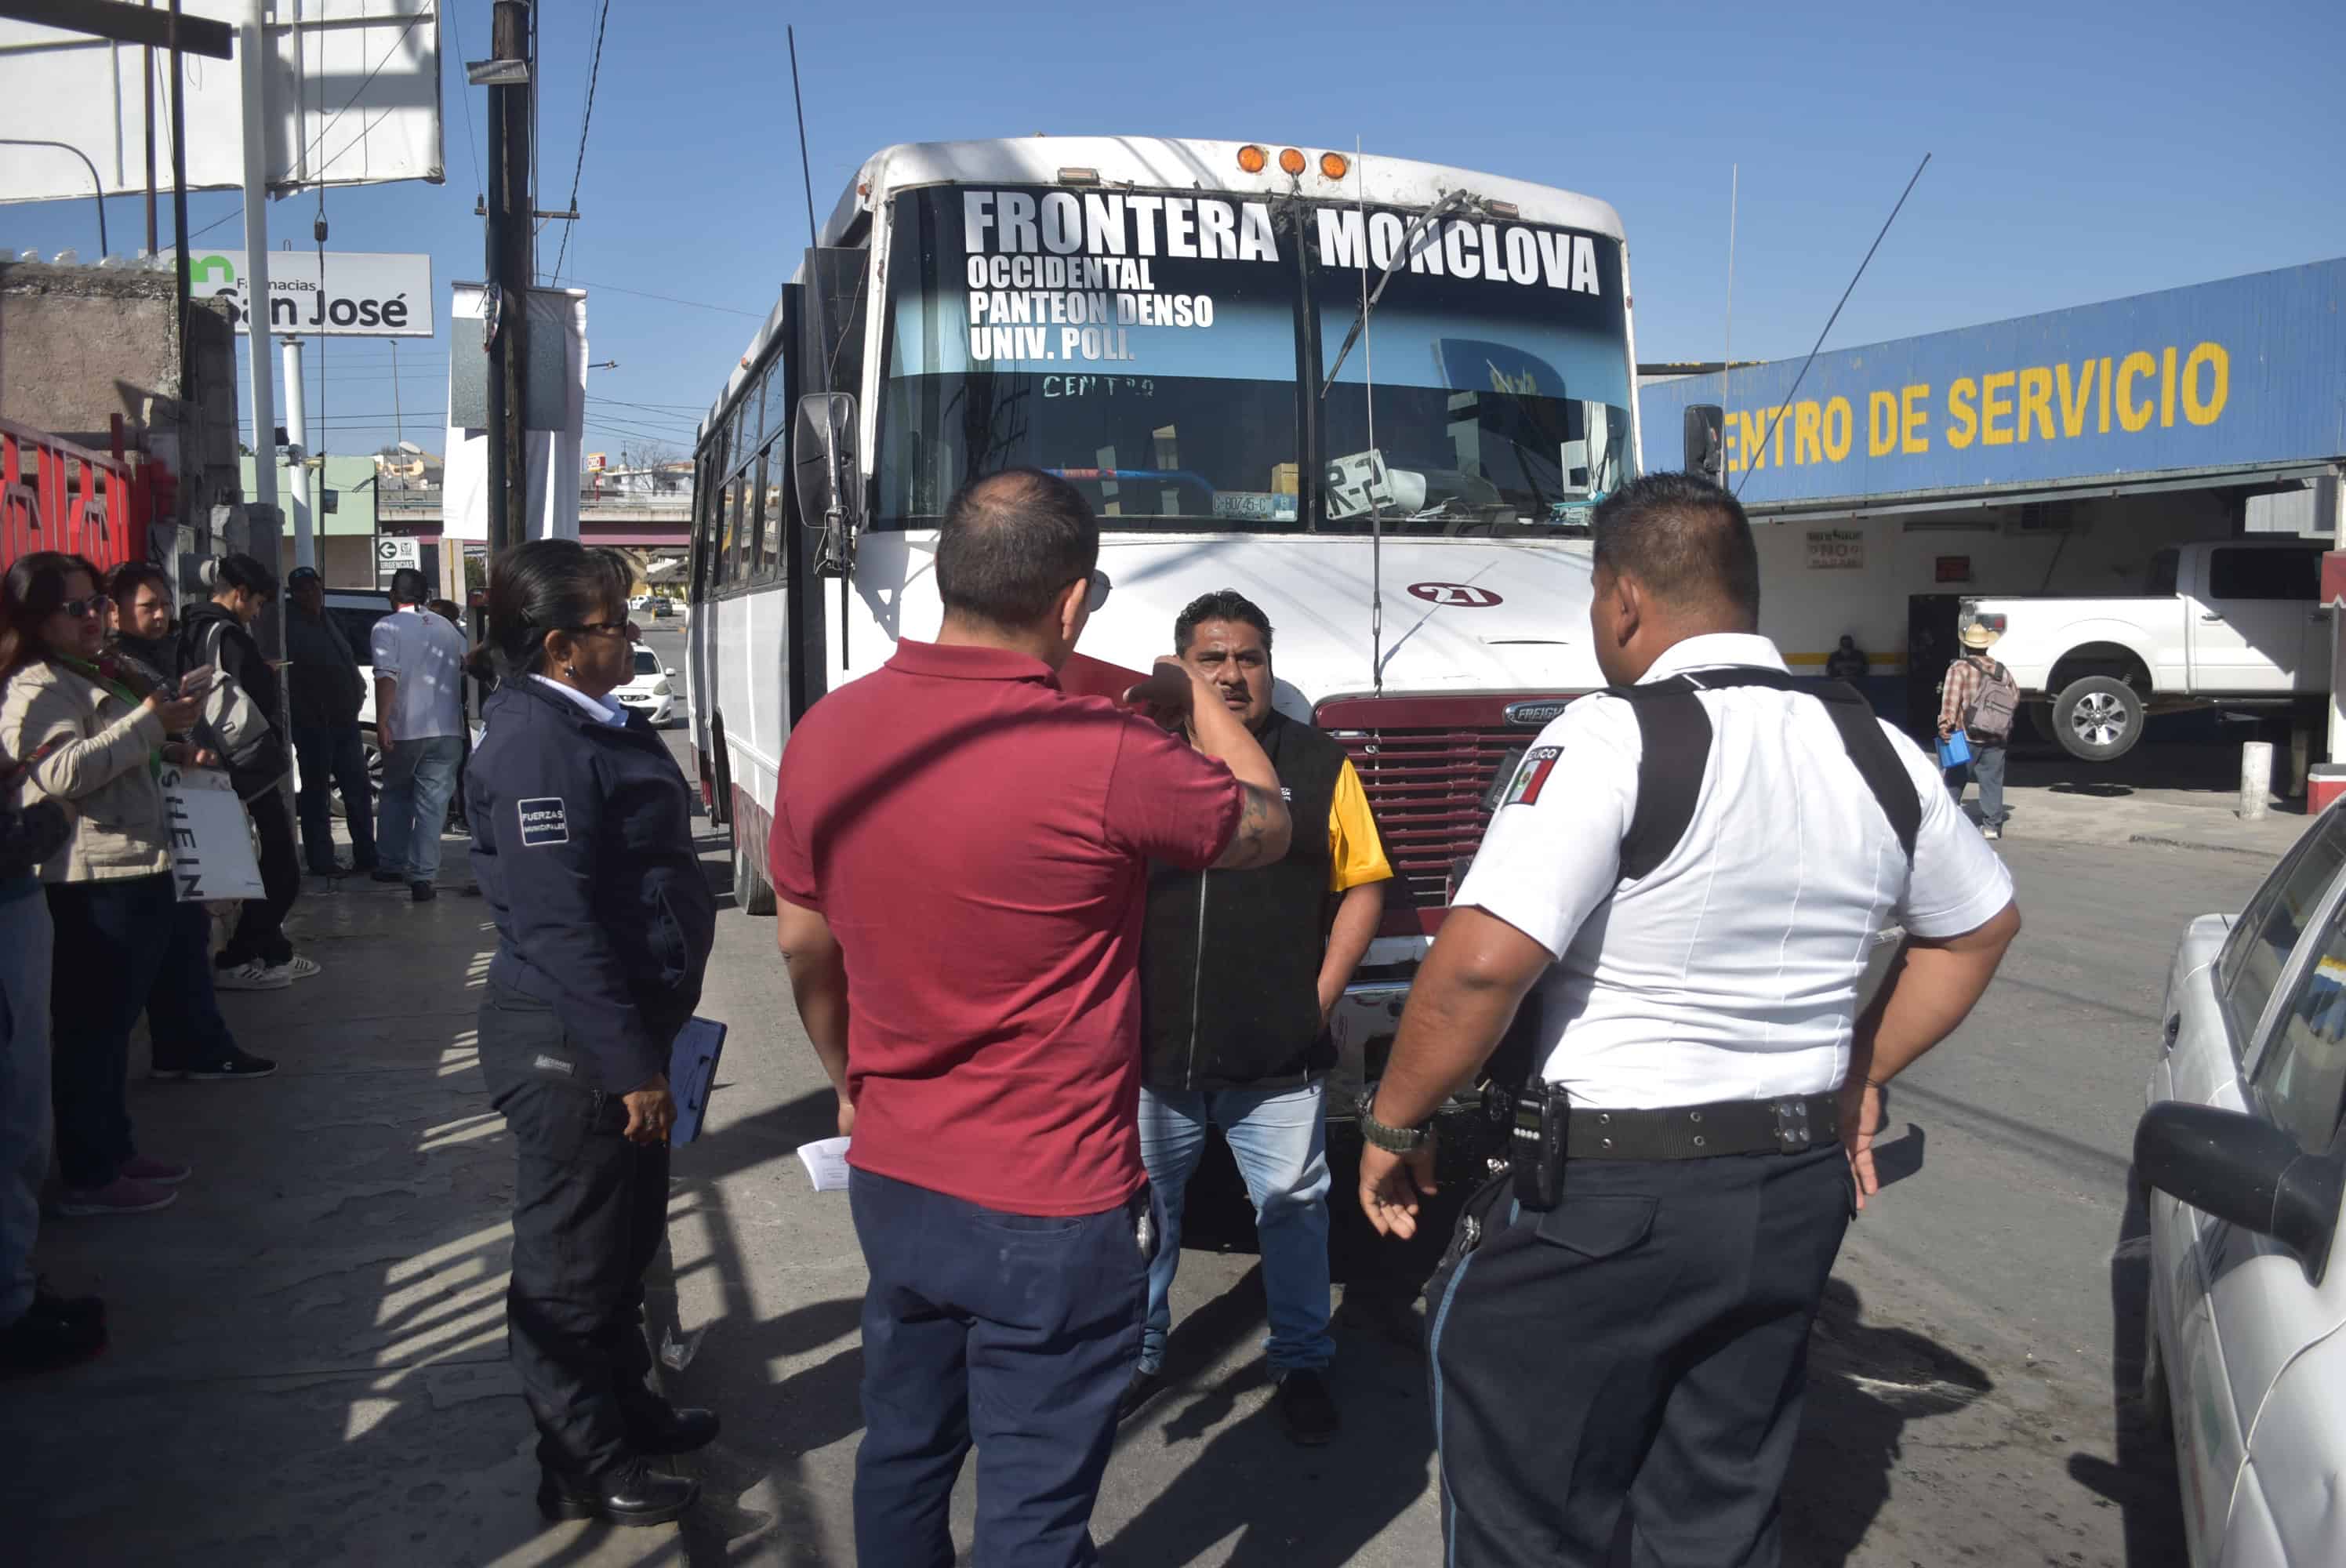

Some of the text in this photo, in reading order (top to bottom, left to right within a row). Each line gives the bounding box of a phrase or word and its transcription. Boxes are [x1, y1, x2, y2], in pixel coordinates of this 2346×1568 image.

[963, 191, 1280, 262] FRONTERA
[1316, 208, 1600, 296] MONCLOVA
[968, 256, 1155, 290] OCCIDENTAL
[309, 290, 408, 328] José
[970, 292, 1214, 328] PANTEON DENSO
[971, 327, 1055, 361] UNIV.
[1724, 342, 2229, 474] ENTRO DE SERVICIO
[162, 769, 204, 897] SHEIN
[522, 810, 564, 822] FUERZAS
